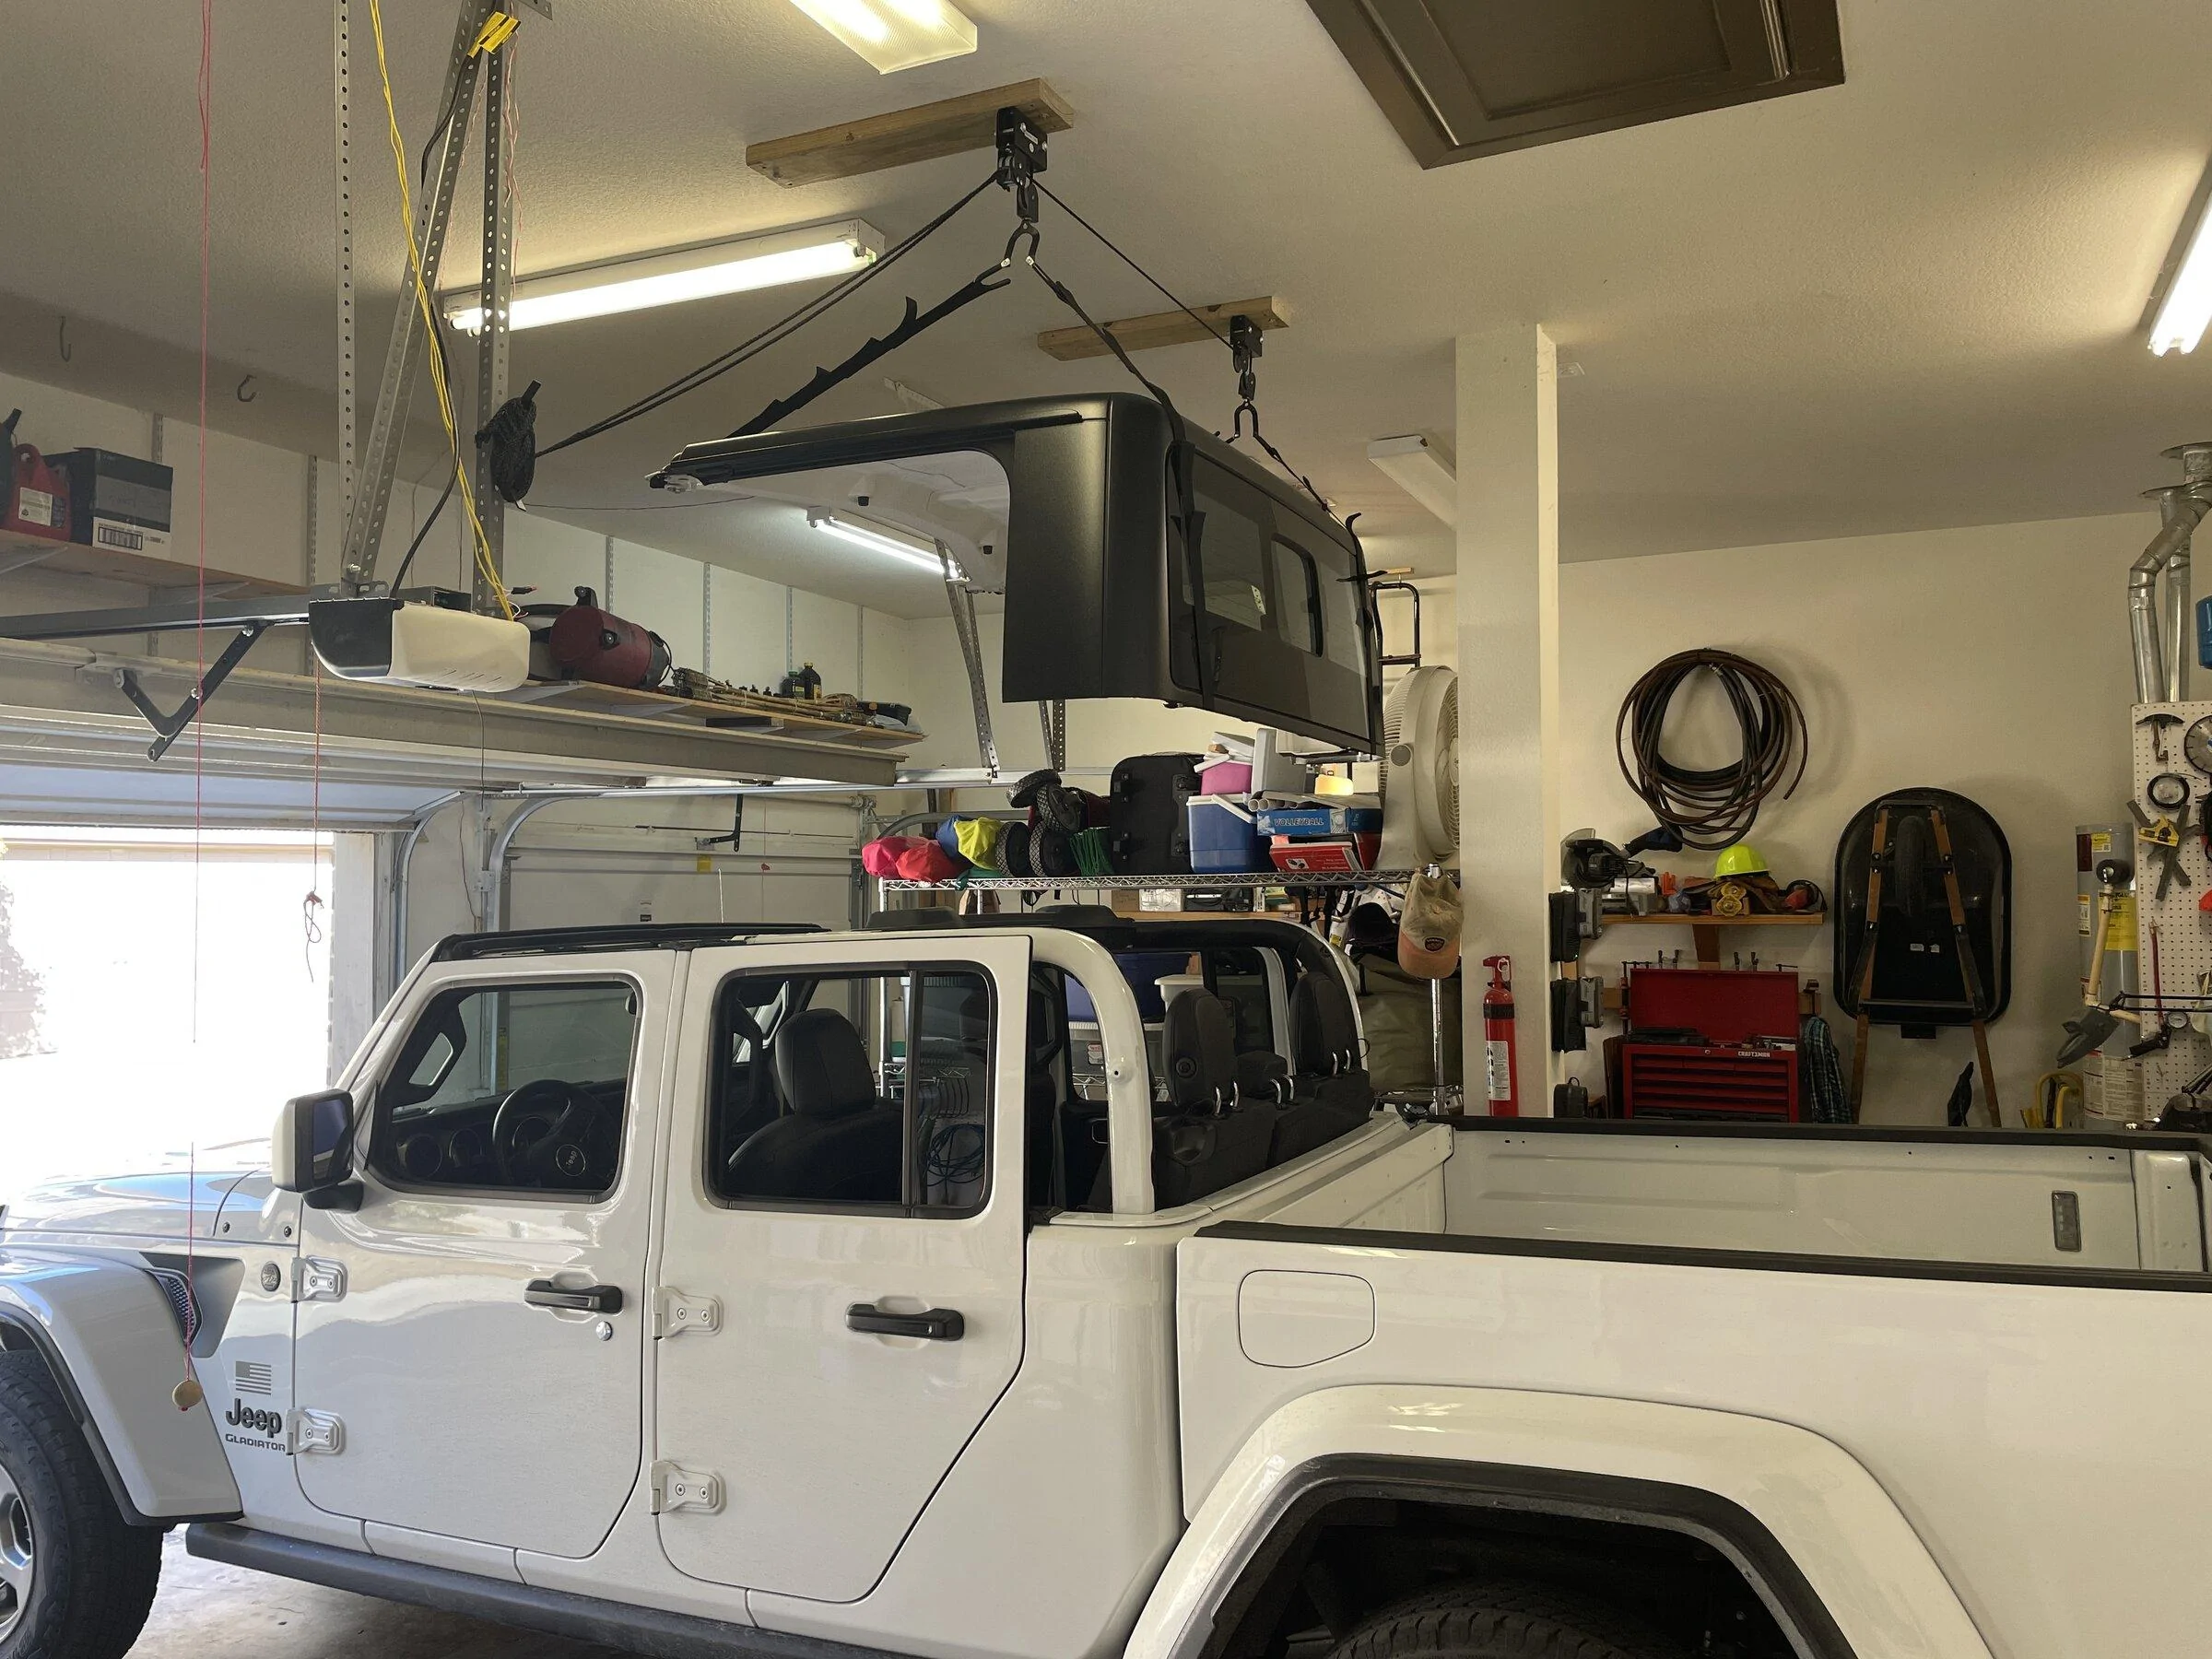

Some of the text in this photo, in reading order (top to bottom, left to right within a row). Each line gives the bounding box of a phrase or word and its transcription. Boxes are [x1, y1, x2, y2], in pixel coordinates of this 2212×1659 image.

[1274, 817, 1324, 827] VOLLEYBALL
[225, 1397, 283, 1439] Jeep
[225, 1433, 286, 1453] GLADIATOR
